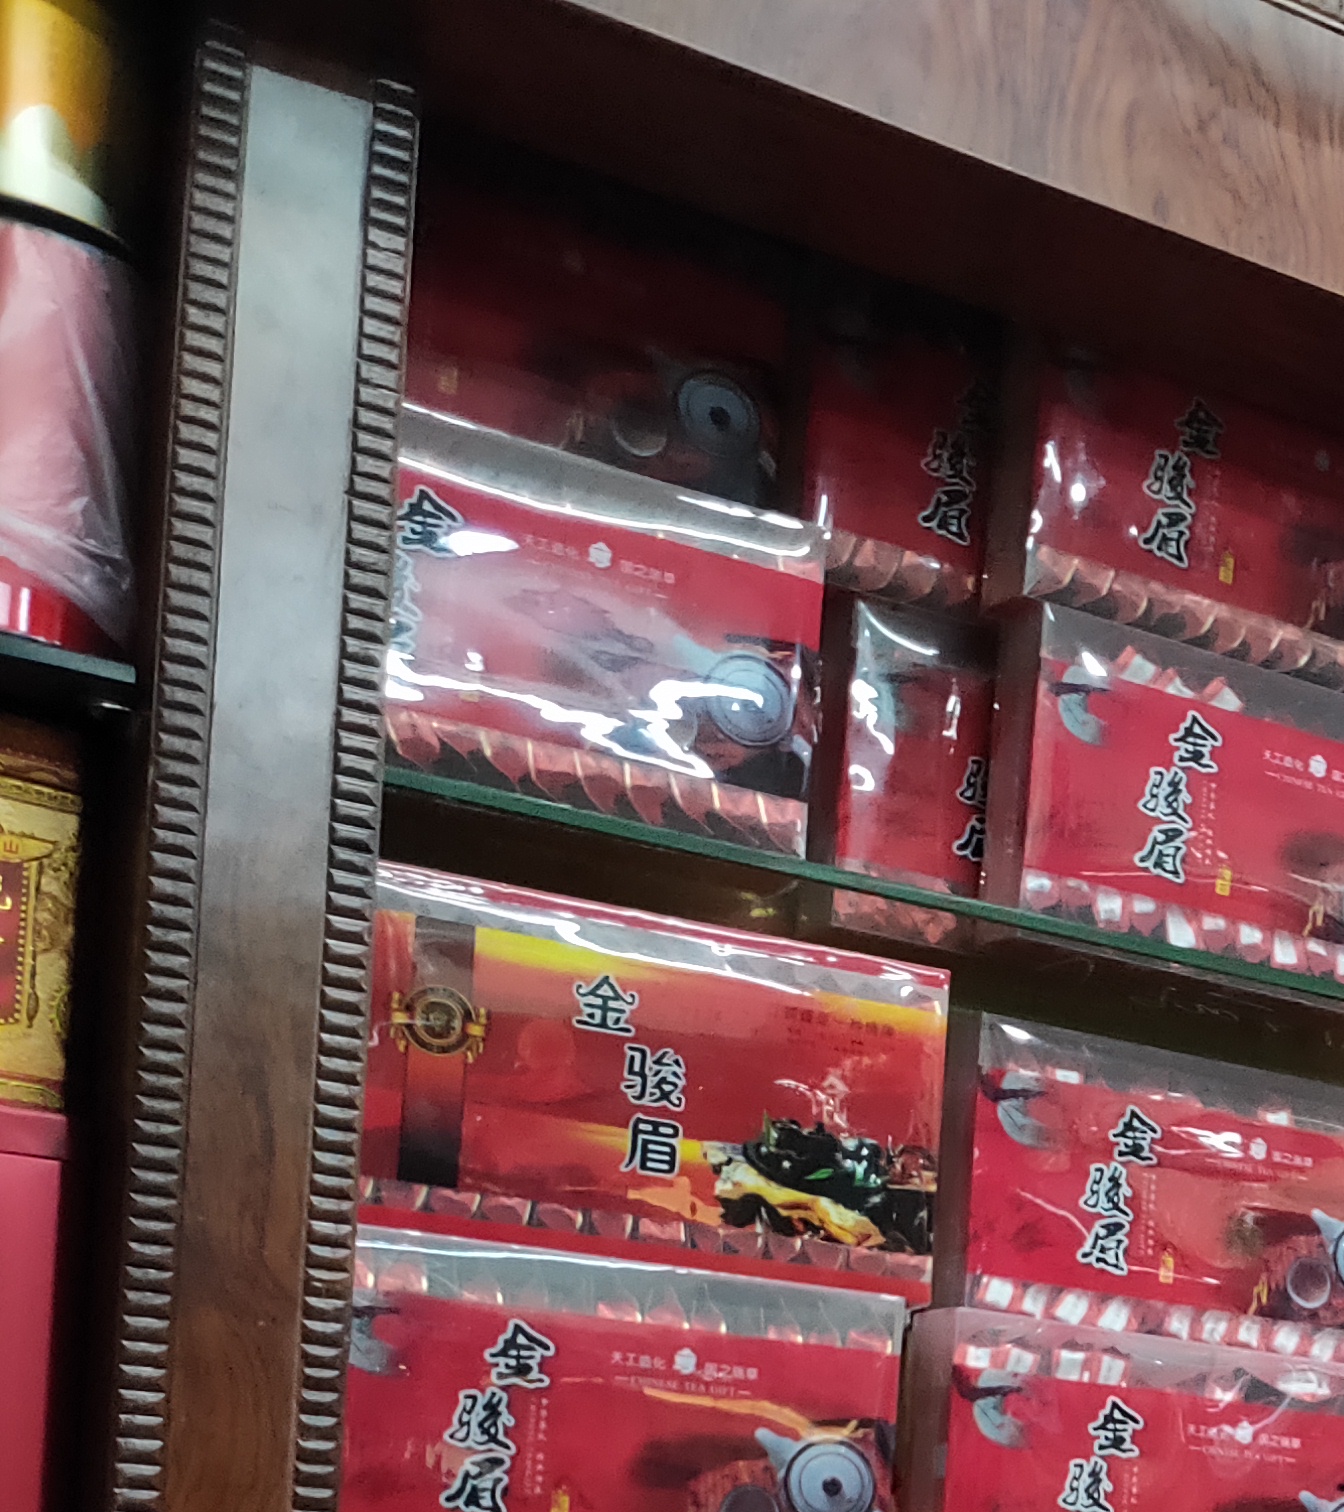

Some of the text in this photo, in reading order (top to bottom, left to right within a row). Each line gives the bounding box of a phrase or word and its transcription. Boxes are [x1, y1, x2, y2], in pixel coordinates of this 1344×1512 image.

[1134, 710, 1222, 884] 金骏眉
[571, 973, 688, 1178] 金骏眉
[1076, 1105, 1163, 1276] 金骏眉
